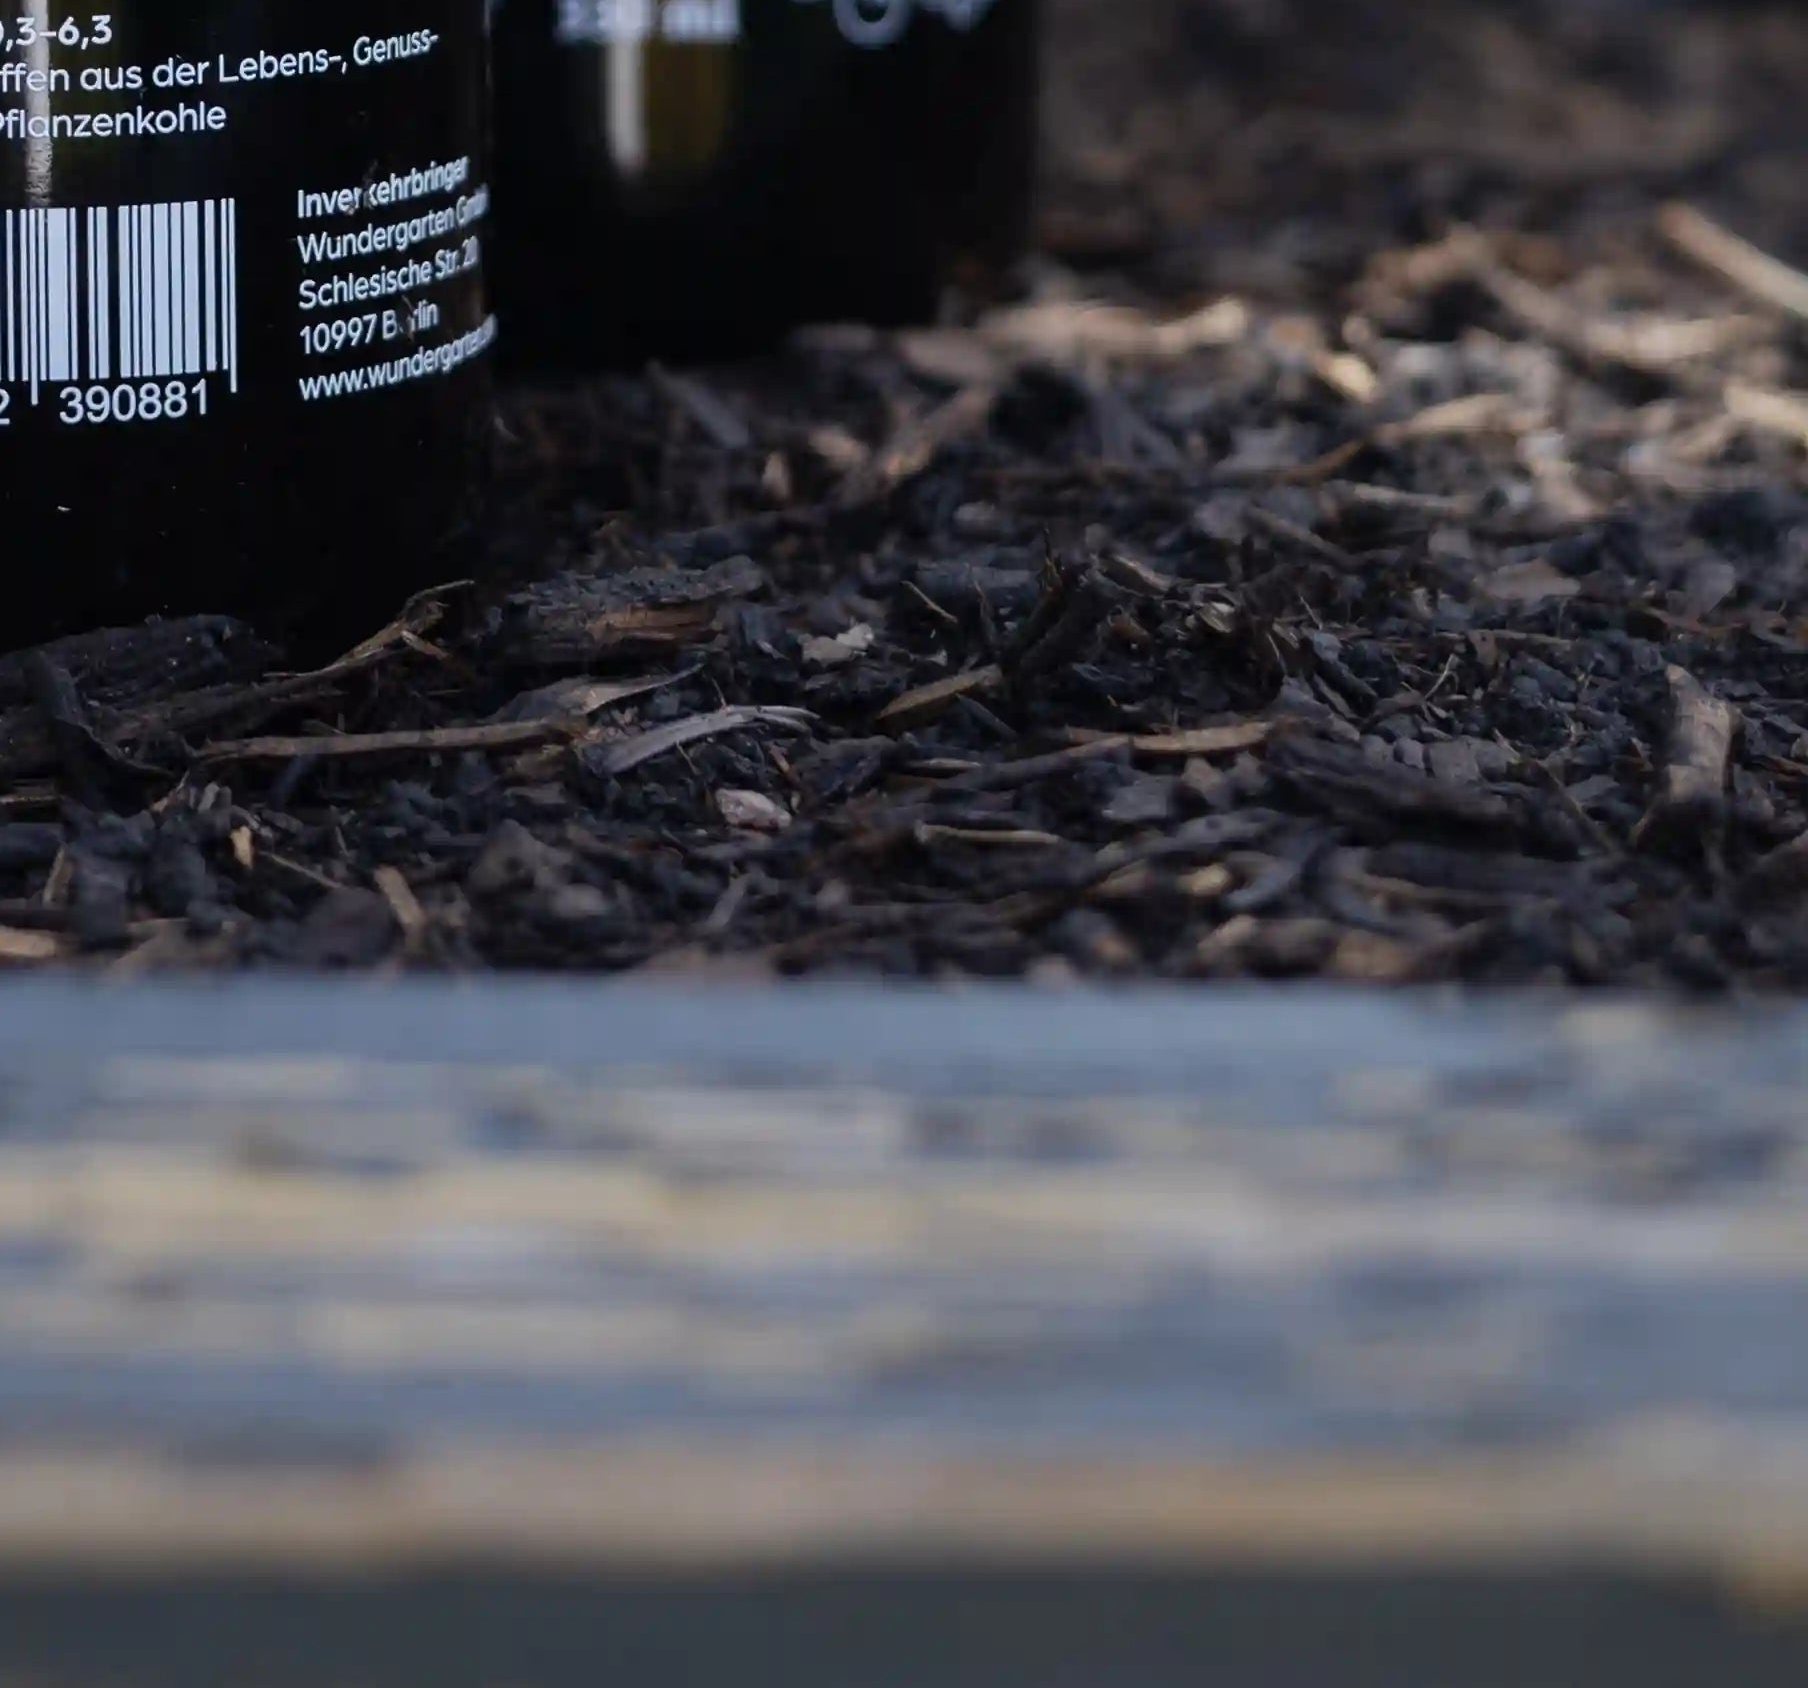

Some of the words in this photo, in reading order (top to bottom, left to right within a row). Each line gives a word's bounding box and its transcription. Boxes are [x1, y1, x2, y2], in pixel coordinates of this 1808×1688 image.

[80, 64, 142, 91] aus
[153, 57, 209, 88] der
[218, 48, 348, 84] Lebens-,
[353, 27, 439, 67] Genuss-
[297, 207, 454, 265] Wundergarten
[297, 258, 433, 311] Schlesische
[299, 312, 378, 355] 10997
[381, 298, 439, 341] Brlin
[59, 378, 209, 425] 390881
